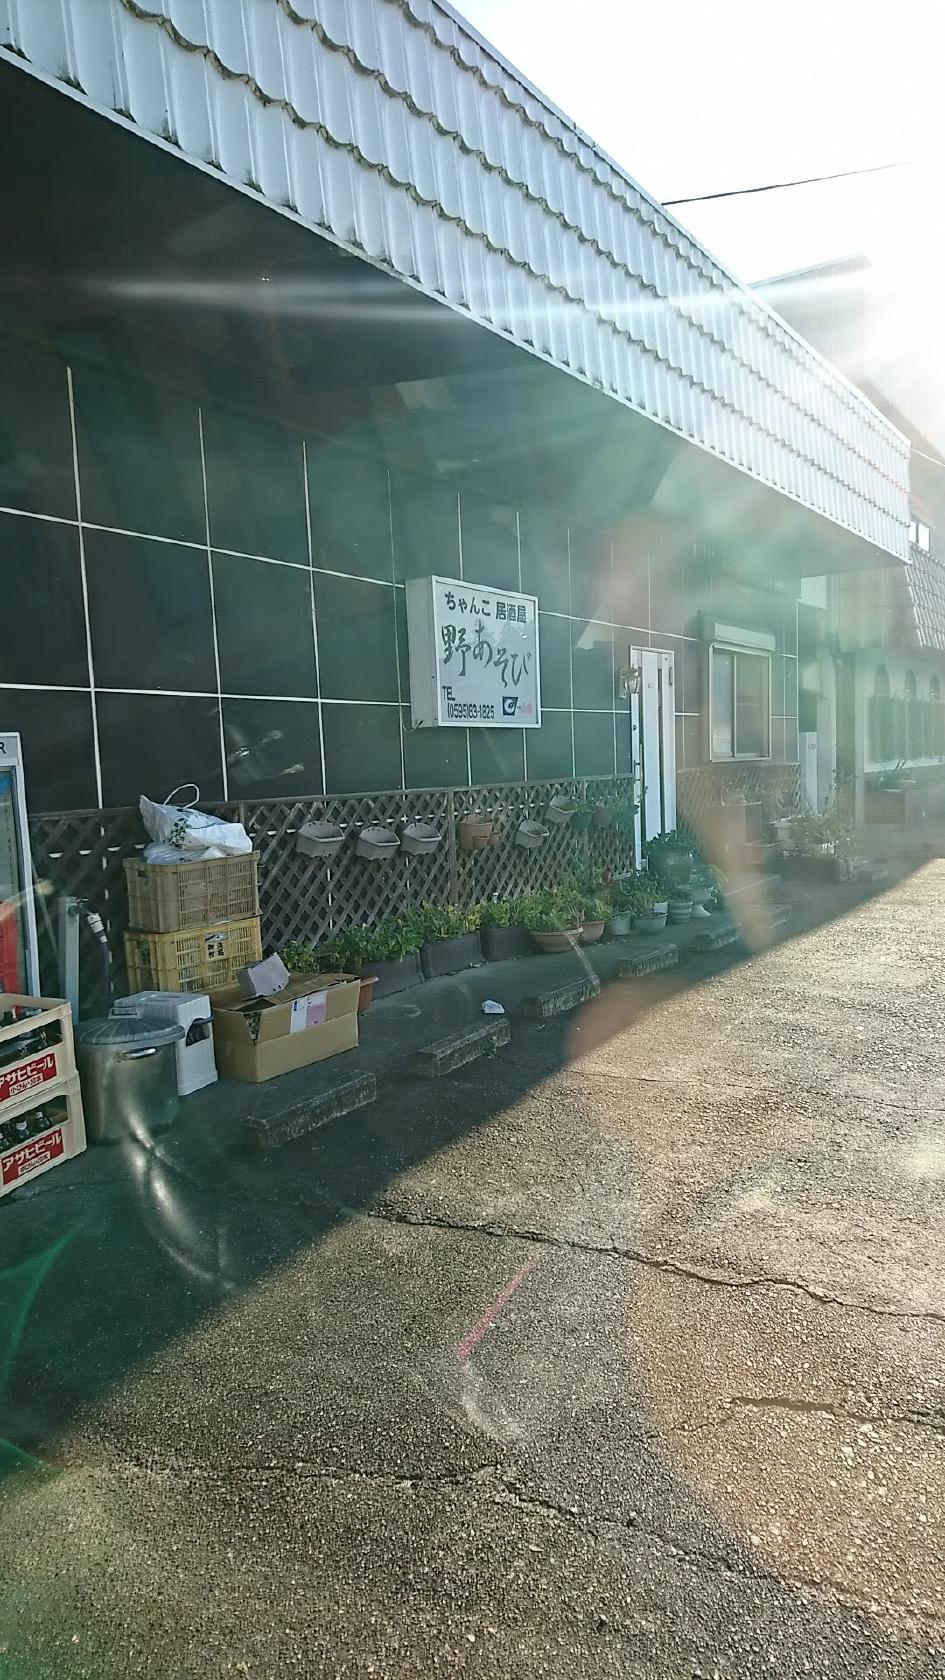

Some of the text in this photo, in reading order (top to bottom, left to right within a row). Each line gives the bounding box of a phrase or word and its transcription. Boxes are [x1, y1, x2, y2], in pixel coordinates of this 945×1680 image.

[445, 592, 527, 623] ちゃんこ 居酒屋
[441, 619, 532, 688] 野あそび
[442, 686, 456, 701] TEL
[3, 1132, 62, 1172] アサヒビール
